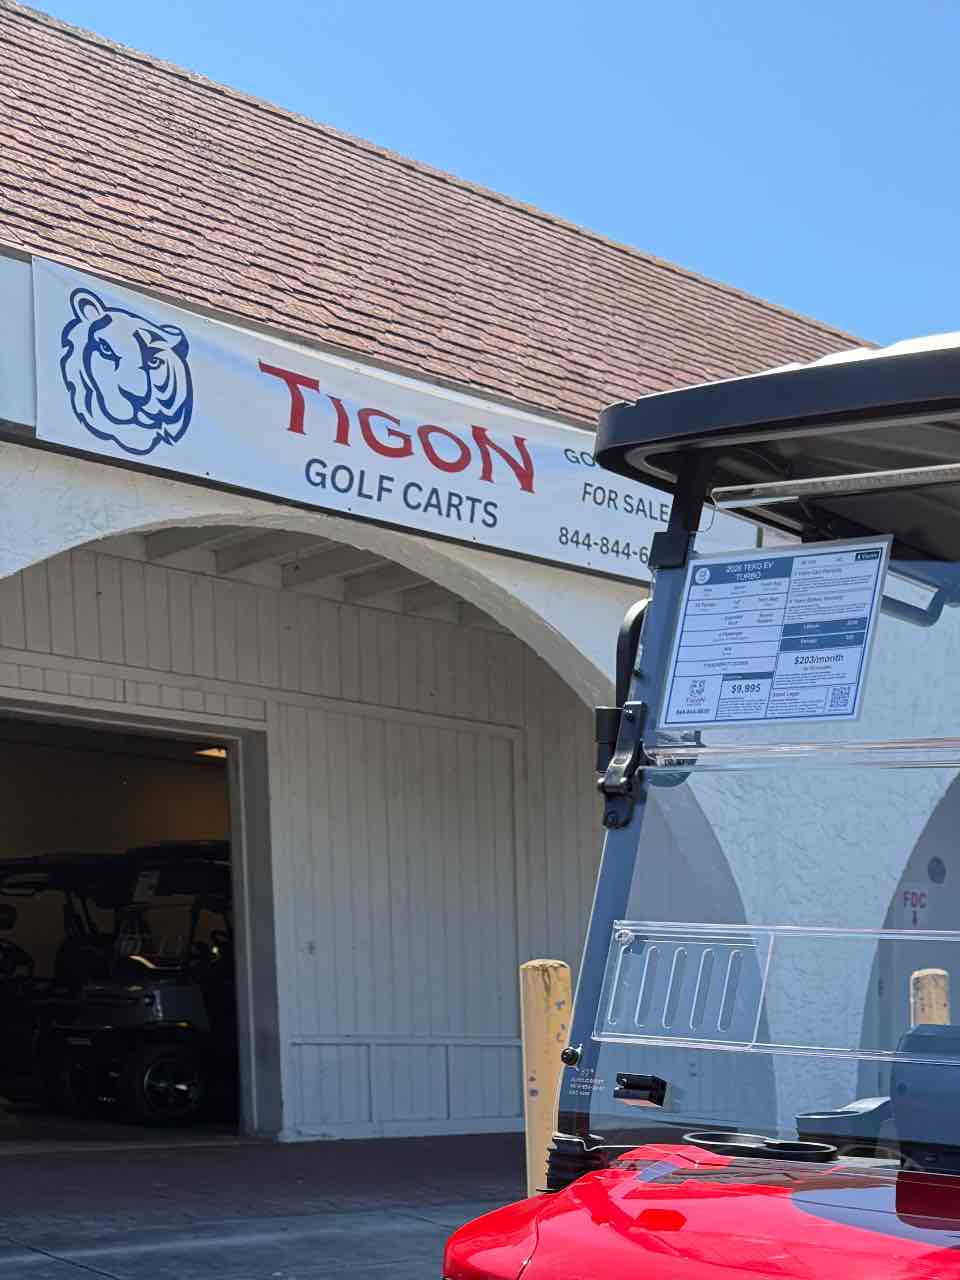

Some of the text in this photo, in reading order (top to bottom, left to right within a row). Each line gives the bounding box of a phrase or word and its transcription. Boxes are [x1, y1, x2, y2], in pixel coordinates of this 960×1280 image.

[258, 360, 536, 494] TIGON
[563, 447, 596, 468] GO
[304, 458, 499, 529] GOLF CARTS
[582, 482, 671, 523] FOR SALE
[558, 526, 650, 565] 844-844-6
[793, 654, 845, 665] $203/month
[903, 890, 927, 911] FDC
